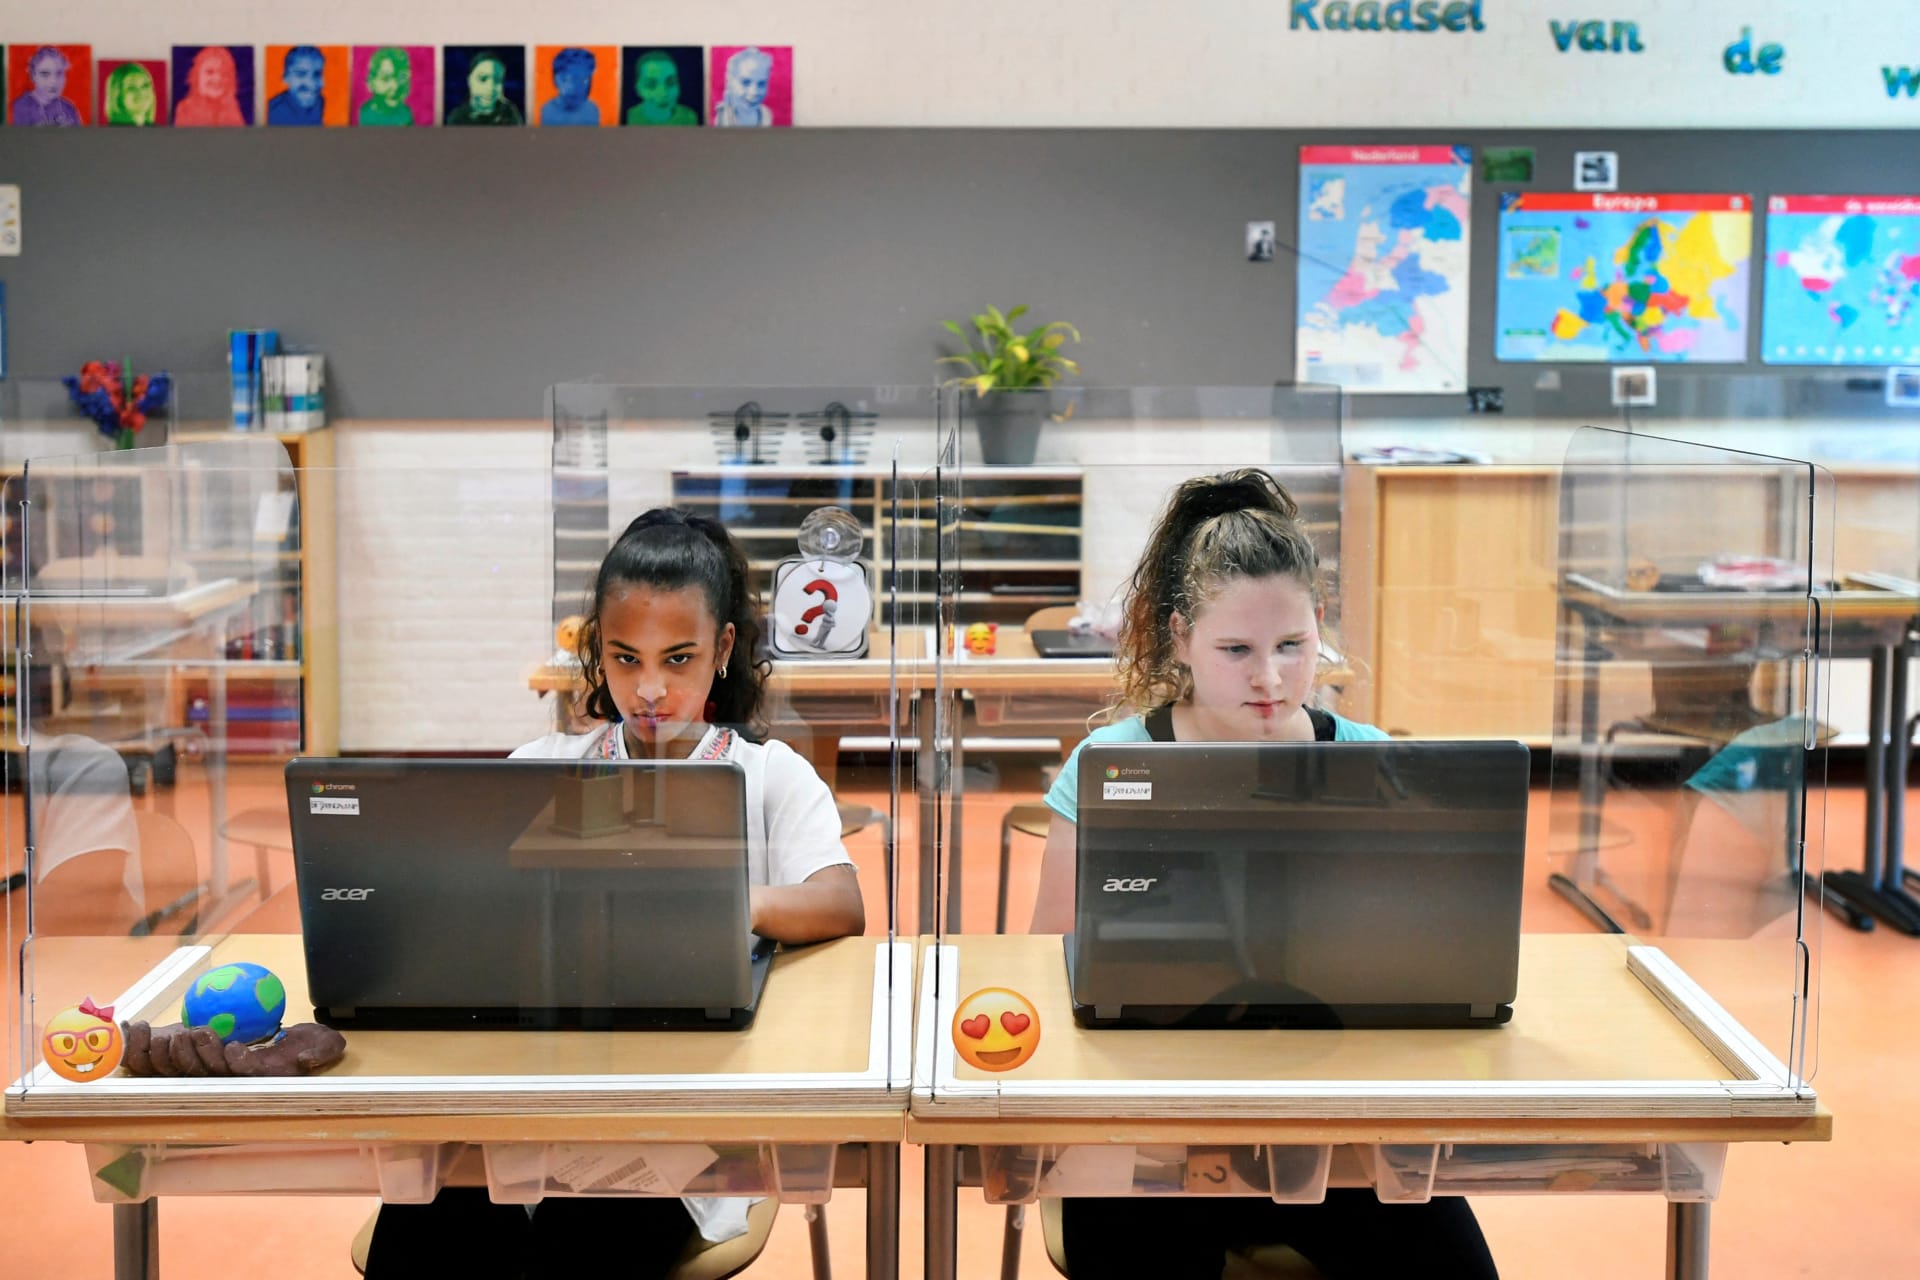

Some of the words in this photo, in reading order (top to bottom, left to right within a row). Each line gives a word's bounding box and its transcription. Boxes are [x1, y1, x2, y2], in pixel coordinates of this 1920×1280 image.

[1550, 19, 1644, 53] van
[1723, 25, 1785, 75] de
[1593, 193, 1658, 212] Europa
[1120, 767, 1151, 776] chrome
[325, 783, 356, 791] chrome
[1102, 878, 1158, 892] acer
[320, 888, 376, 901] acer
